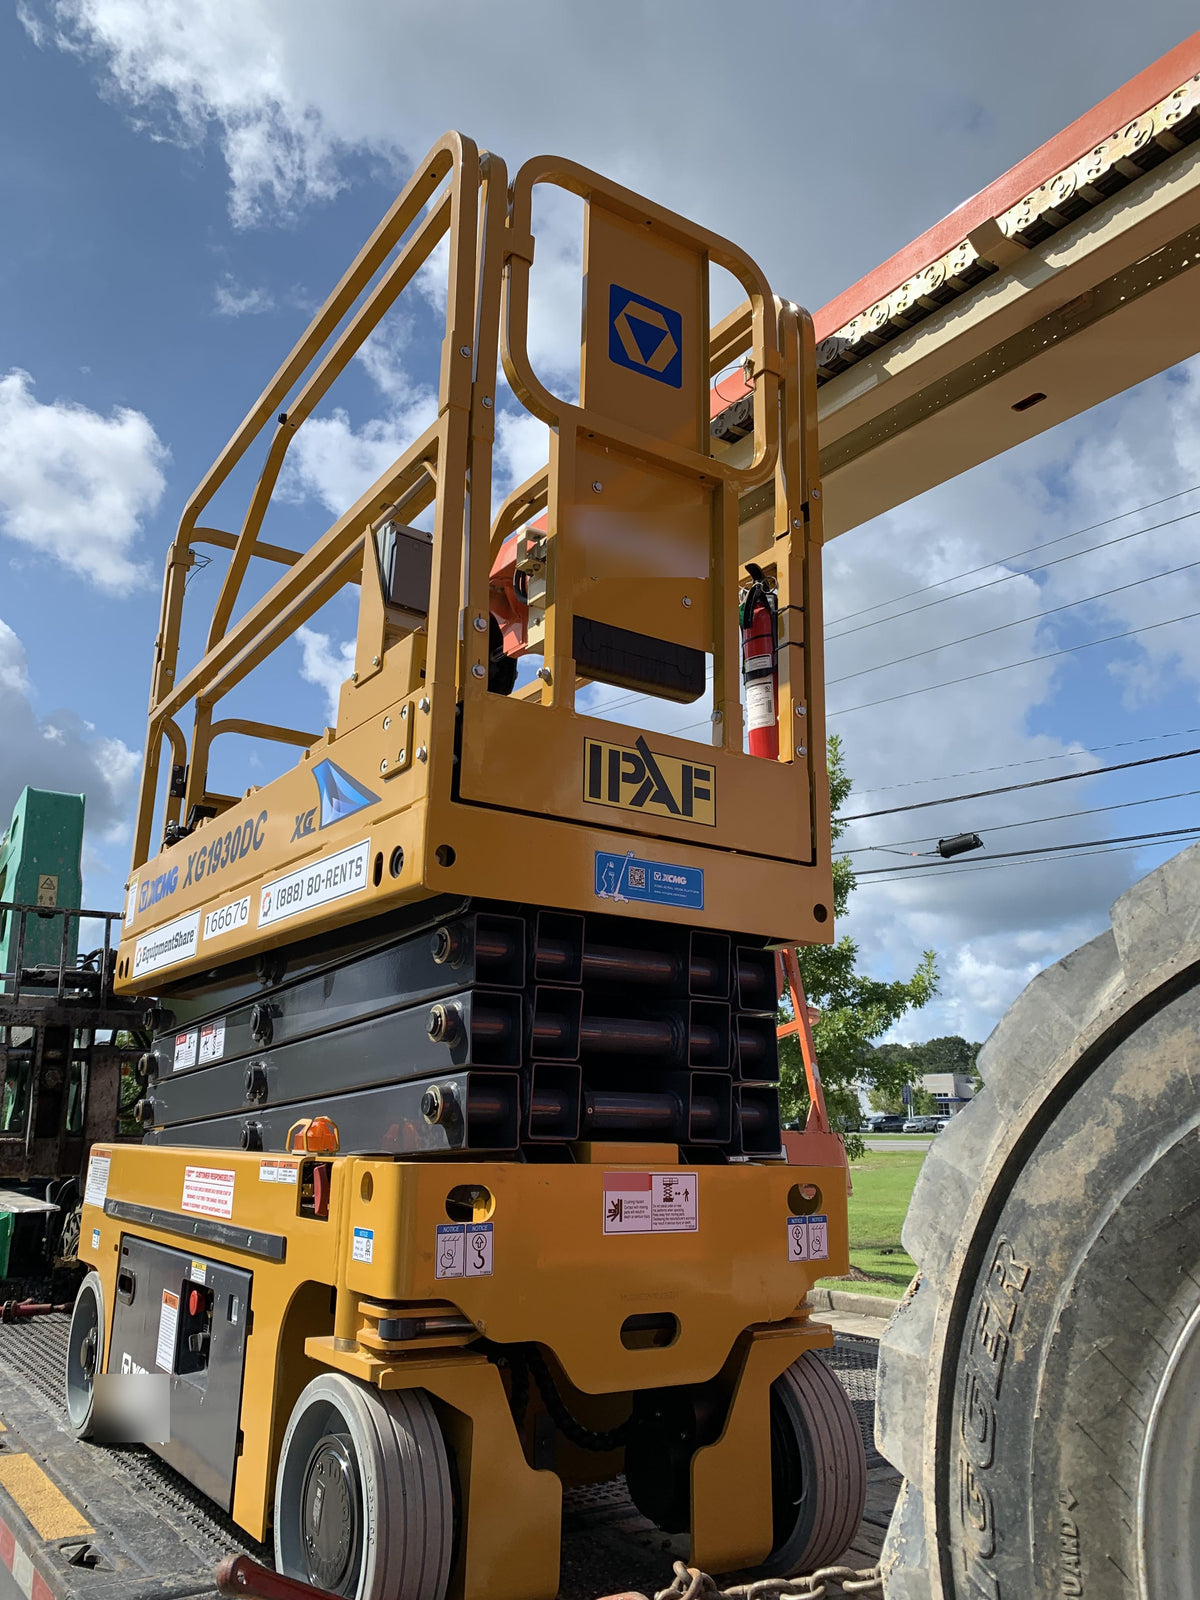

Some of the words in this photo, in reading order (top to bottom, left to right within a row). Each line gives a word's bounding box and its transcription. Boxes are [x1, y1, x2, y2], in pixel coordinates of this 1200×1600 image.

[590, 735, 710, 817] IPAF
[290, 806, 318, 843] XG
[148, 866, 178, 905] XCMG
[182, 810, 268, 889] XG1930DC
[662, 874, 687, 884] XCMG
[276, 879, 304, 910] (888)
[307, 856, 362, 896] 80-RENTS
[206, 898, 248, 935] 166676
[142, 930, 195, 963] EquipmentShare
[1059, 1516, 1083, 1600] UARD
